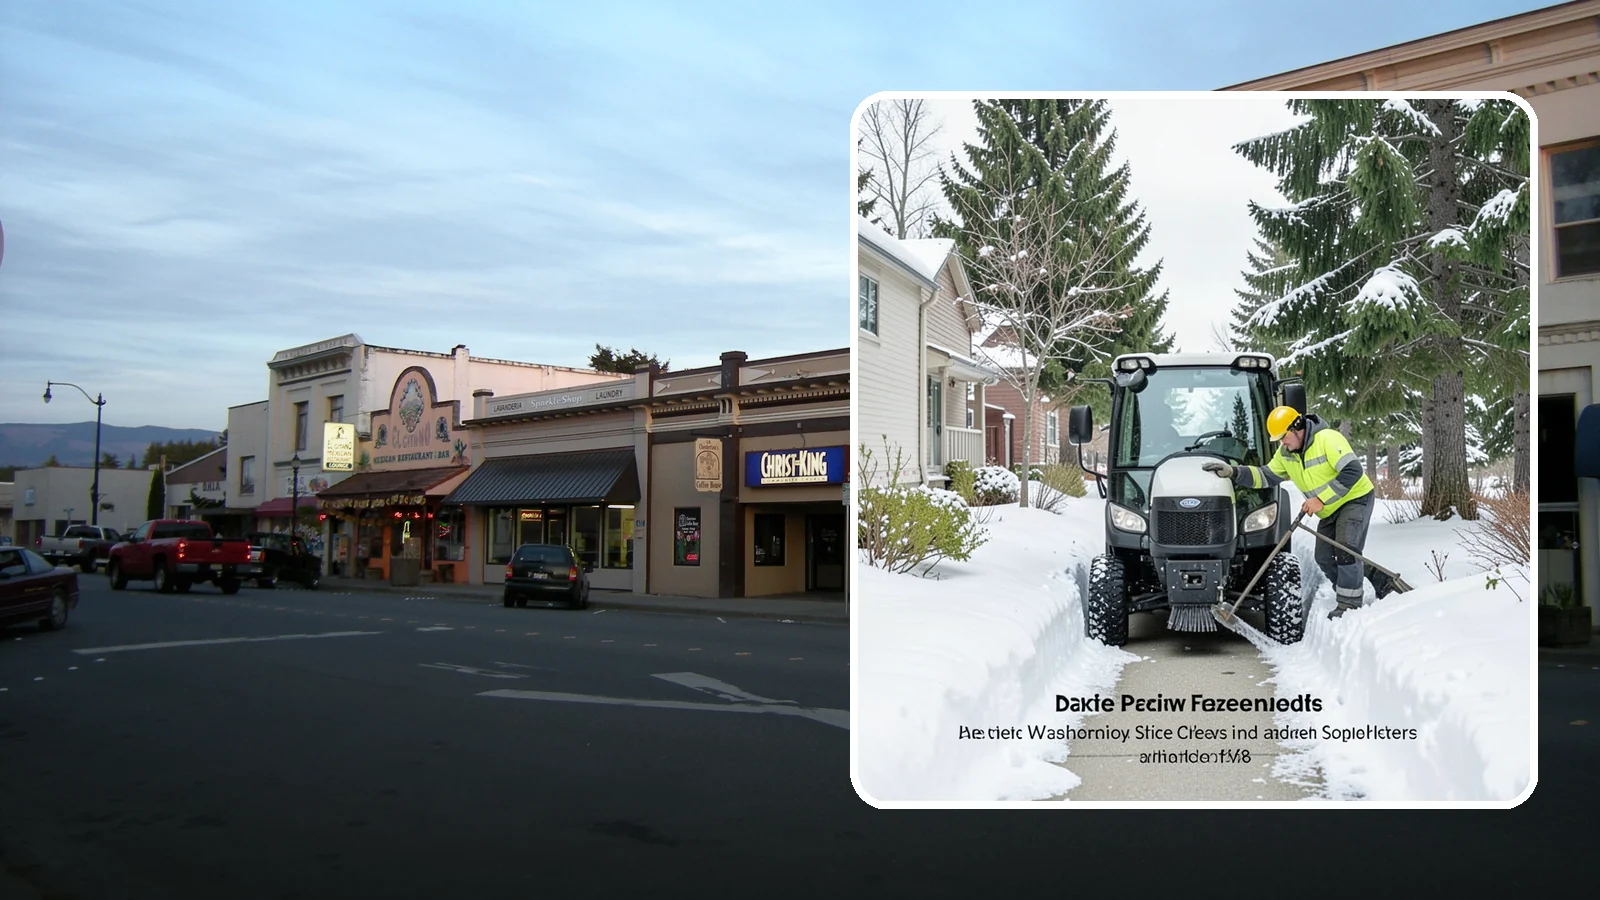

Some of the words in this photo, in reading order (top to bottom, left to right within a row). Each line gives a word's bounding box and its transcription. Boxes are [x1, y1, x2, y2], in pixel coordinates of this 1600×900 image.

[562, 394, 583, 405] Shop
[596, 389, 623, 399] LAUNDRY
[493, 402, 522, 412] LAVANDERIA
[373, 454, 396, 464] MEXICAN
[397, 451, 433, 462] RESTAURANT
[437, 450, 450, 459] BAR
[761, 452, 797, 478] CHRIST
[799, 450, 827, 476] KING
